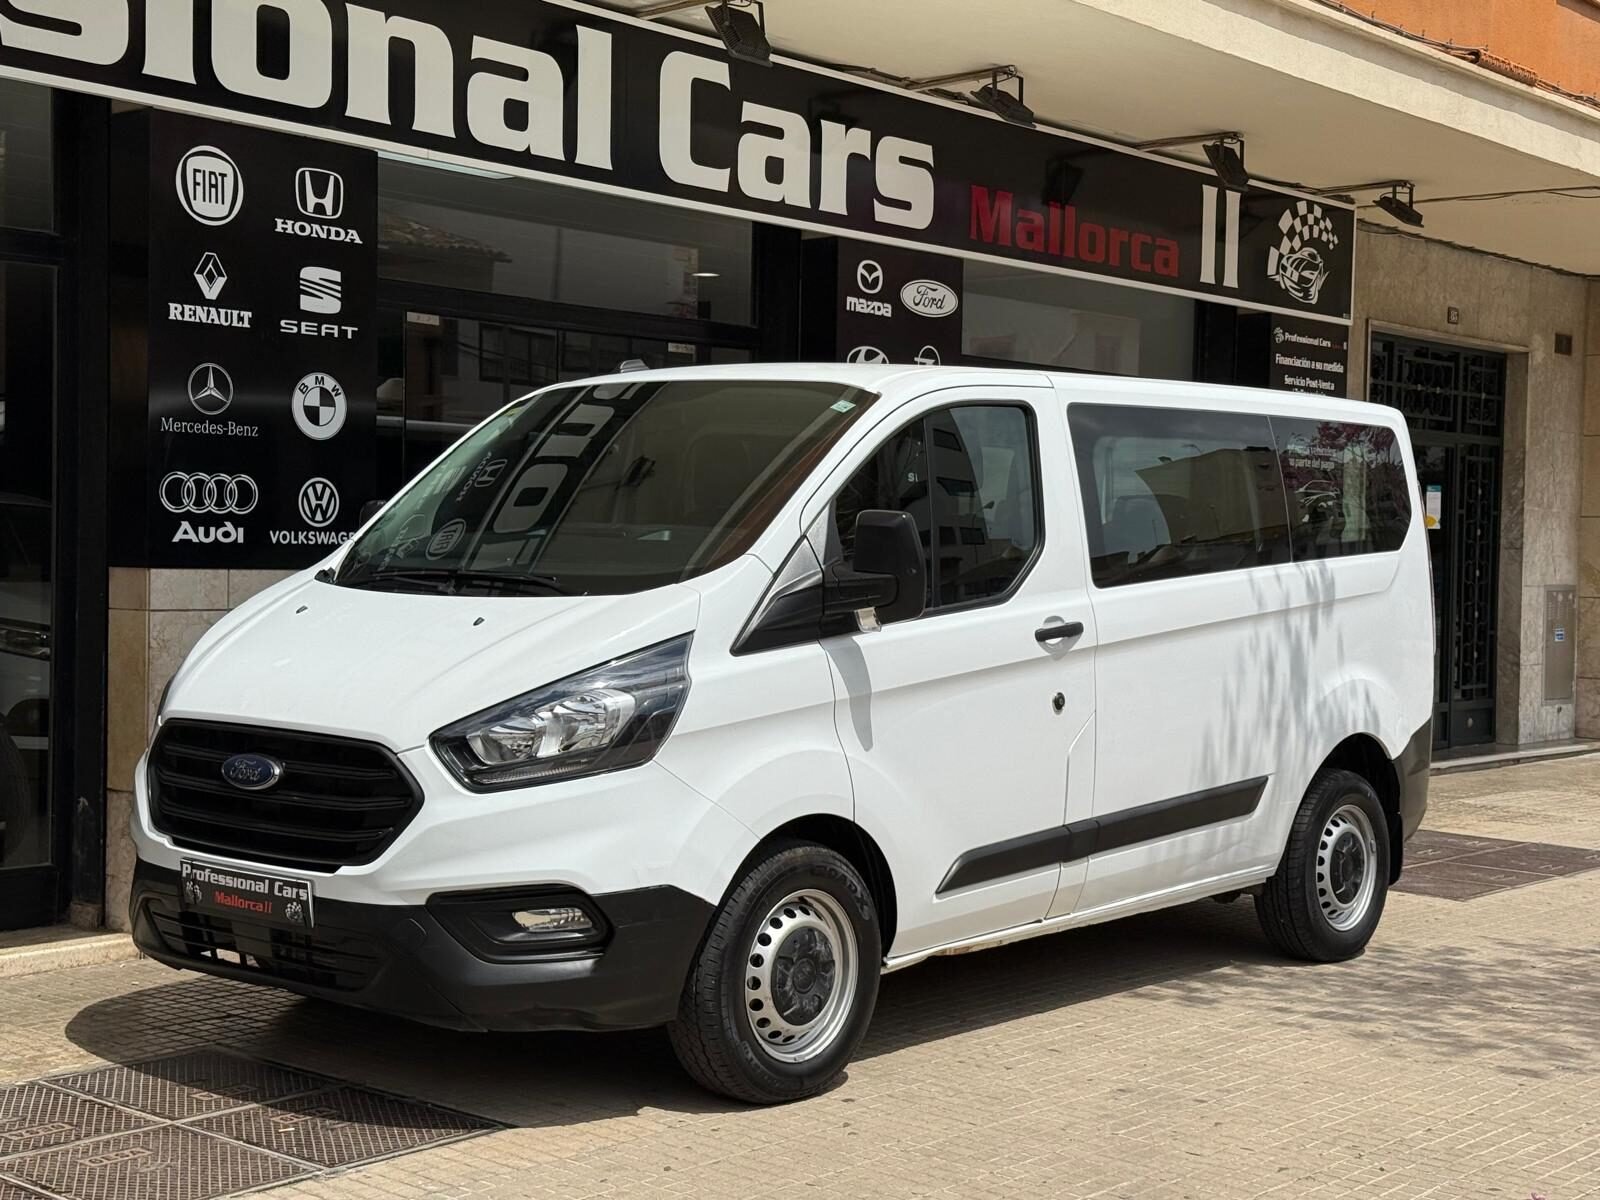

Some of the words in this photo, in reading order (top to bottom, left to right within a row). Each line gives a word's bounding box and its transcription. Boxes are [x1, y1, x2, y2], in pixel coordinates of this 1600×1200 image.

[659, 50, 935, 231] Cars
[970, 185, 1180, 278] Mallorca
[192, 168, 228, 205] FIAT
[274, 217, 363, 244] HONDA
[846, 296, 892, 318] mazda
[912, 285, 946, 310] Ford
[168, 302, 252, 328] RENAULT
[280, 319, 359, 339] SEAT
[1284, 332, 1319, 346] Professional
[1319, 338, 1331, 348] Cars
[1275, 353, 1310, 368] Financiación
[1323, 362, 1344, 373] medida
[298, 375, 342, 398] BMW
[1284, 374, 1305, 386] Servicio
[160, 417, 259, 437] Mercedes-Benz
[171, 520, 244, 544] Audi
[230, 758, 261, 781] Ford
[182, 863, 269, 894] Professional
[274, 882, 308, 901] Cars
